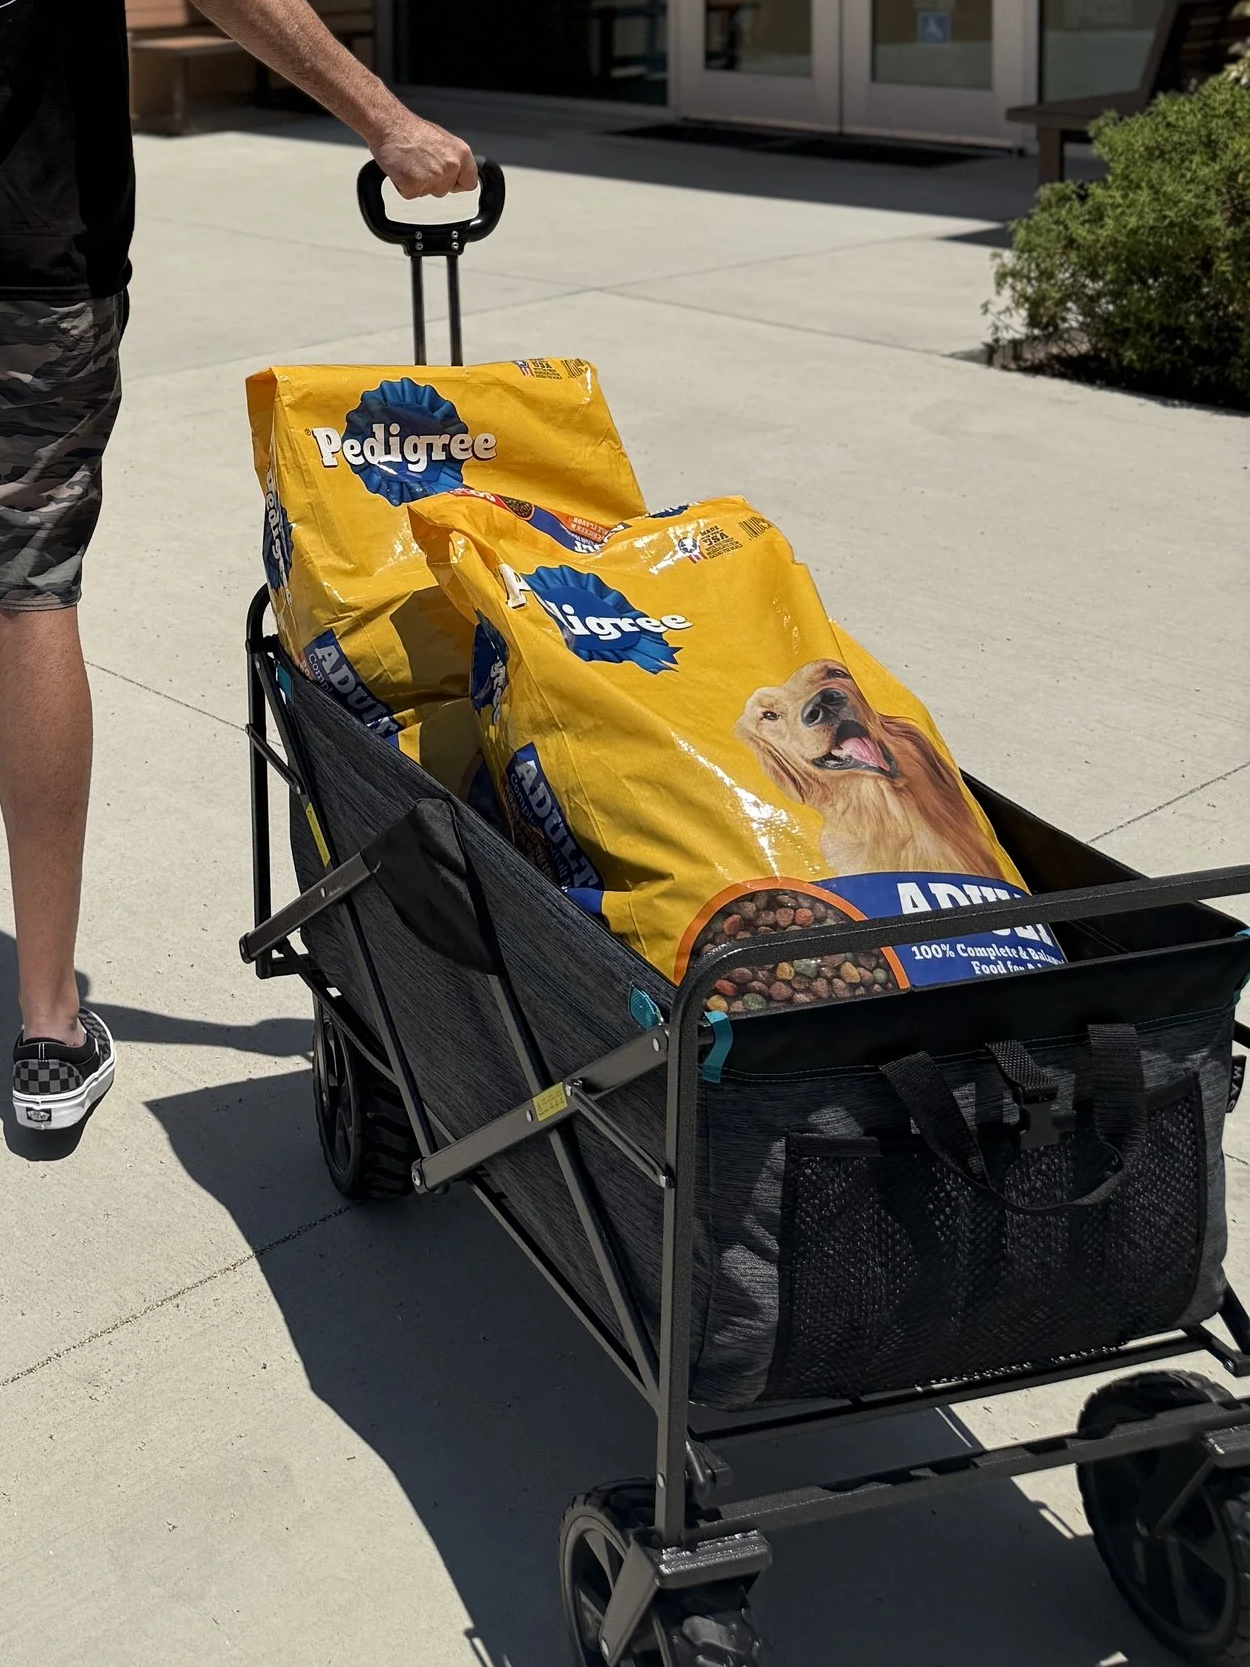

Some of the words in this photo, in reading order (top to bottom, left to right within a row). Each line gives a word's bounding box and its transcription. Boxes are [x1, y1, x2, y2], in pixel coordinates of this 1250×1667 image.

[312, 422, 498, 473] Pedigree
[498, 563, 694, 641] Pigree
[515, 760, 600, 888] ADULT
[911, 943, 955, 960] 100%
[956, 943, 1019, 960] Complete
[1018, 946, 1029, 960] &
[971, 961, 1008, 975] Food
